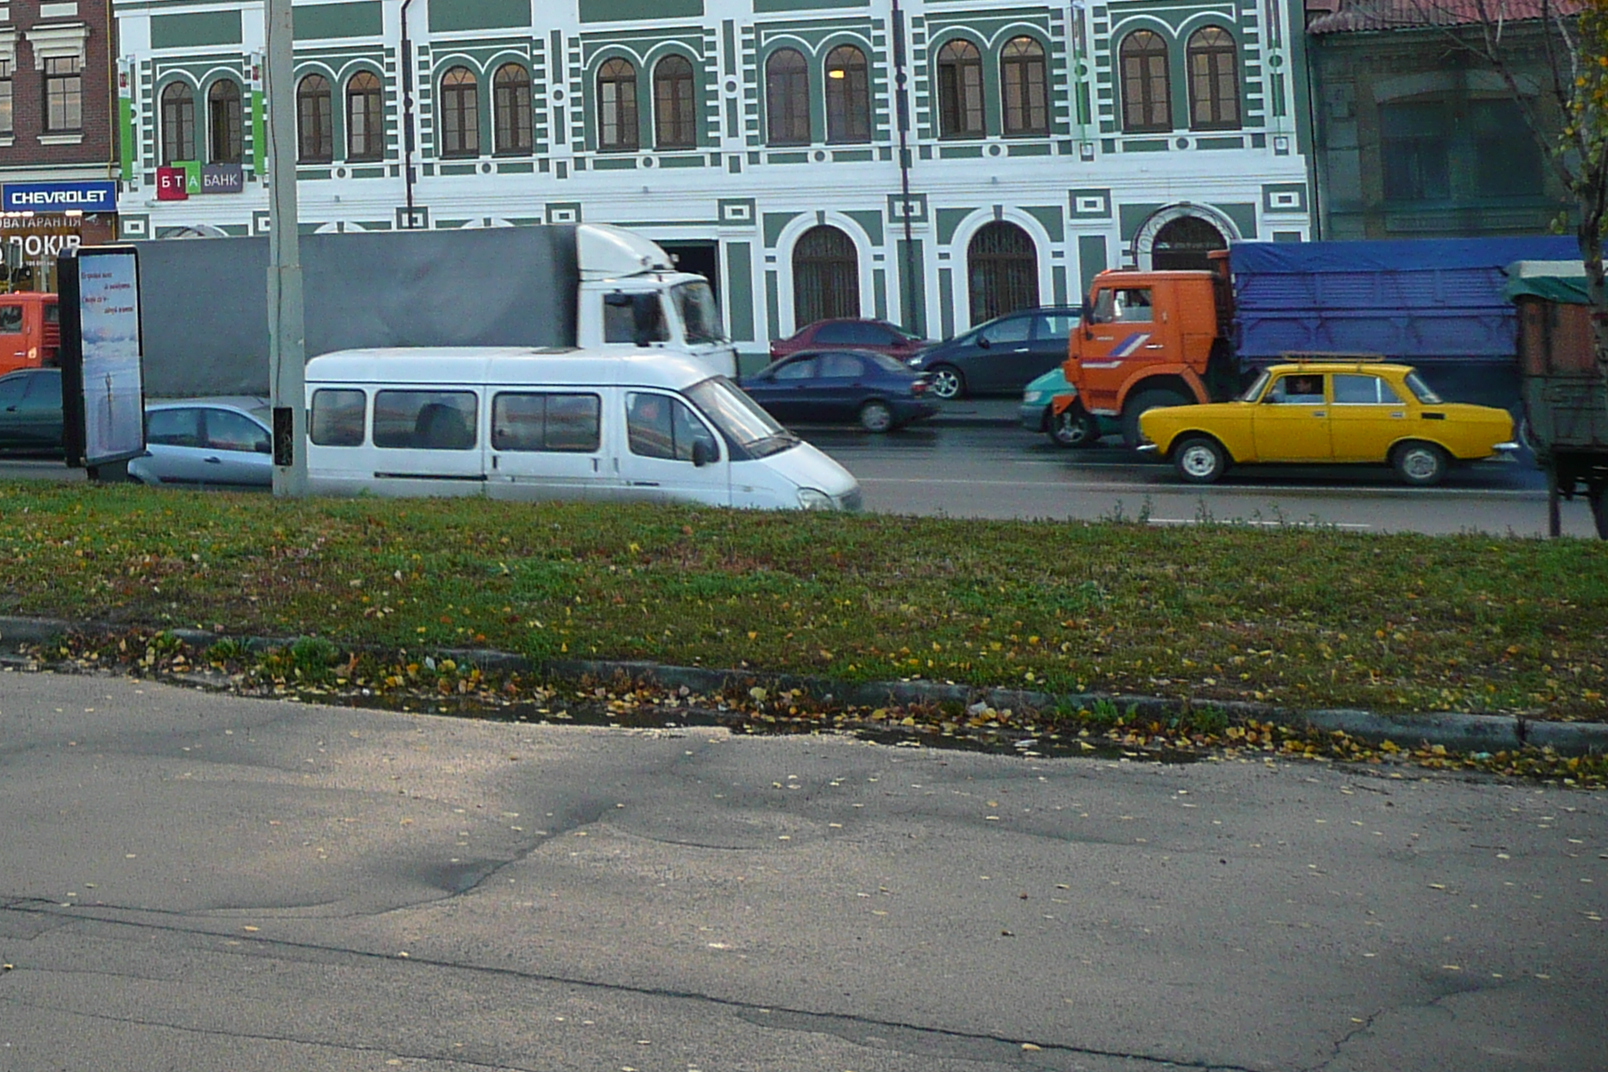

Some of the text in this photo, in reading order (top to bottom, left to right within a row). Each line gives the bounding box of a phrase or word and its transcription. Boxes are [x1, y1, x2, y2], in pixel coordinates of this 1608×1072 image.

[161, 173, 238, 188] БТА БАНК
[11, 189, 107, 205] CHEVROLET
